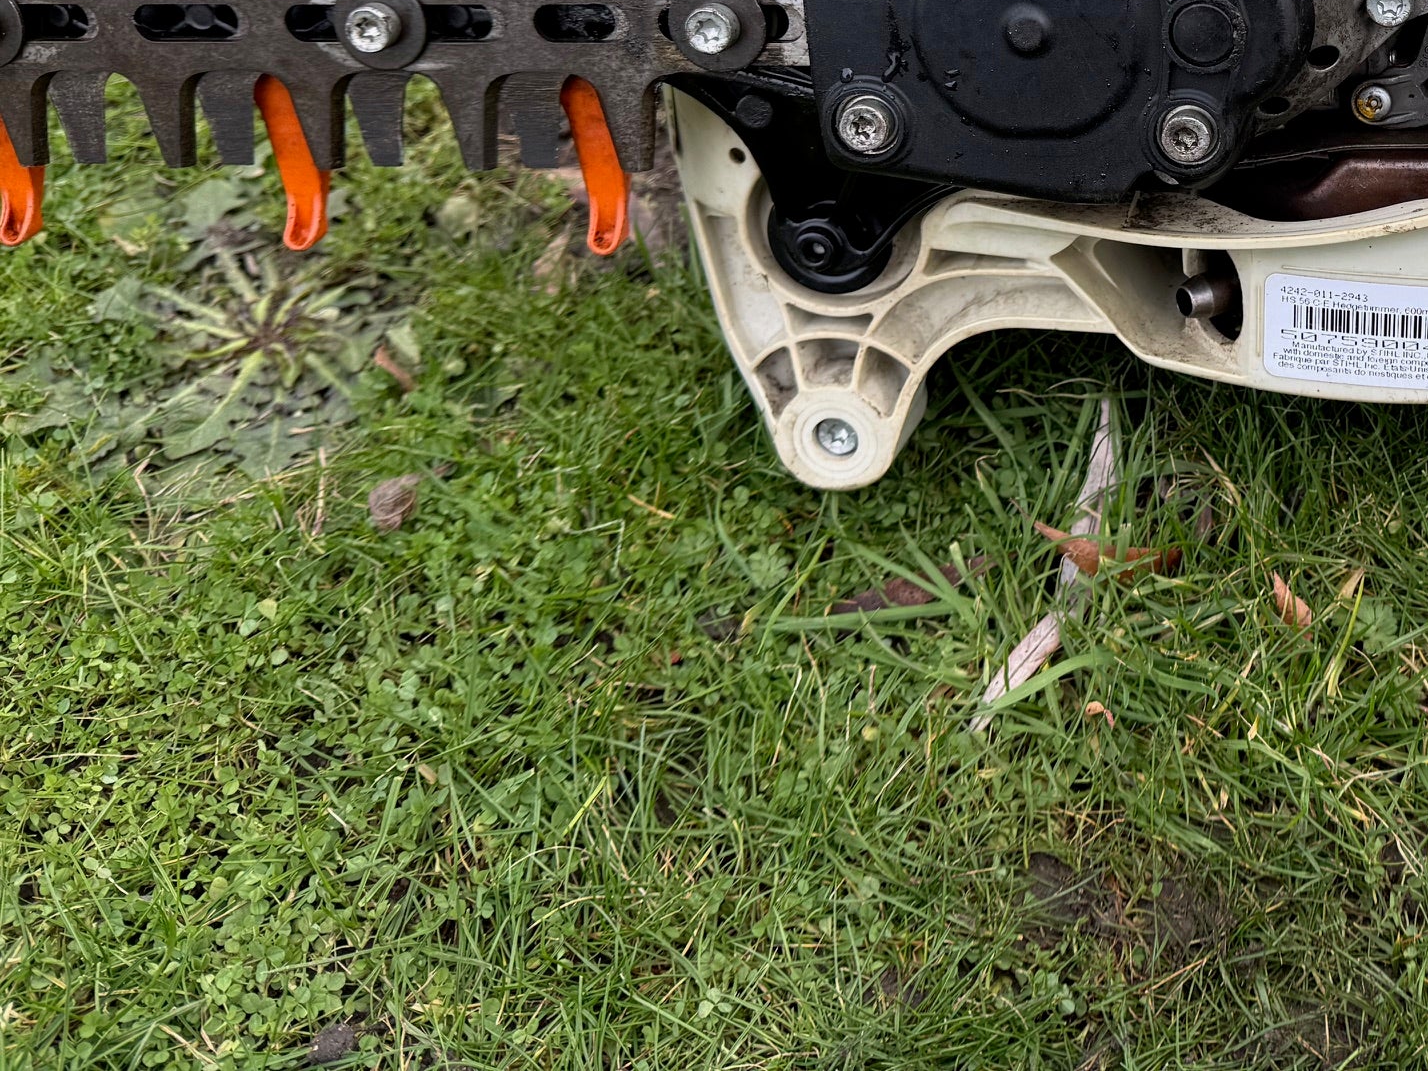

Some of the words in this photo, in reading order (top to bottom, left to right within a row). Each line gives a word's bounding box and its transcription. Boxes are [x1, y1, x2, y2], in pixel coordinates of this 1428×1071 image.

[1280, 286, 1368, 302] 4242-011-2943
[1281, 295, 1297, 304] HS
[1300, 298, 1310, 306] 56
[1283, 347, 1301, 356] with
[1303, 349, 1344, 360] domestic
[1347, 354, 1364, 362] and
[1367, 356, 1398, 365] foreign
[1292, 341, 1355, 355] Manufactured
[1356, 346, 1368, 356] by
[1371, 348, 1400, 358] STIHL
[1273, 352, 1312, 366] Fabrique
[1315, 357, 1329, 367] par
[1332, 359, 1362, 369] STIHL
[1278, 361, 1295, 369] des
[1297, 364, 1352, 374] composants
